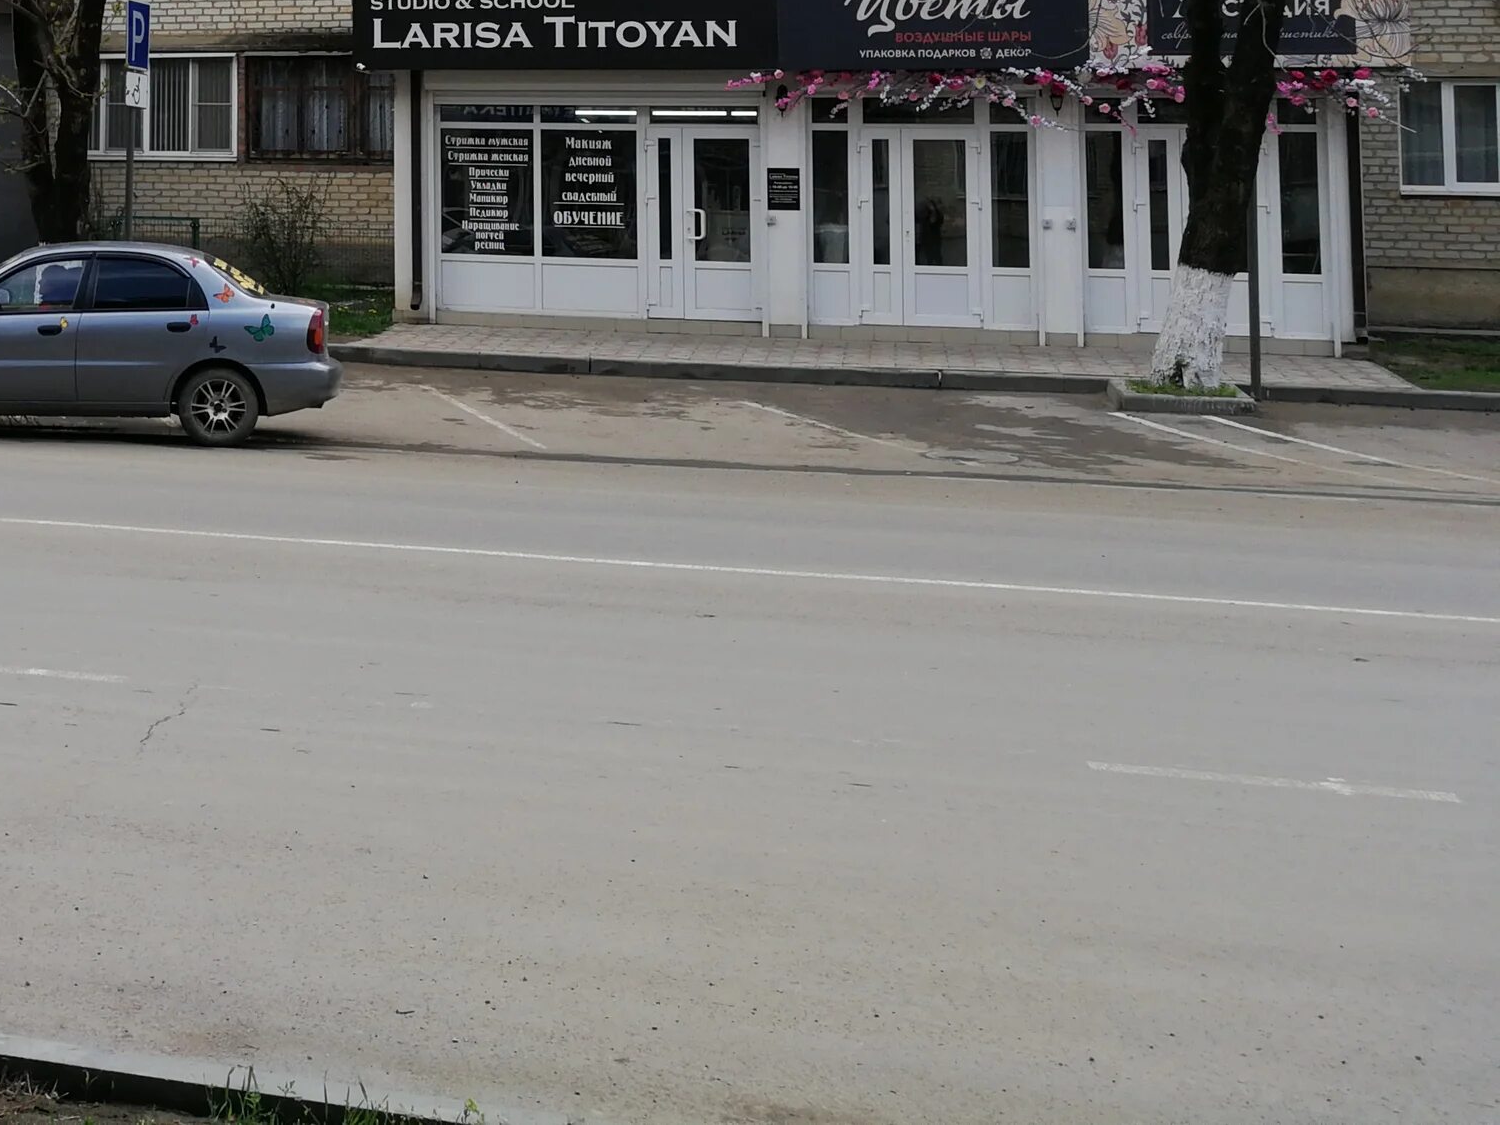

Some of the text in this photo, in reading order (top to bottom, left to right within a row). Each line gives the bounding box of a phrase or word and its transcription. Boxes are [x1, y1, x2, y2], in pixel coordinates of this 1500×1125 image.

[131, 10, 145, 62] P
[895, 30, 1032, 44] ВОЗДУШНЫЕ ШАРЫ
[859, 48, 1032, 59] УПАКОВКА ПОДАРКОВ ДЕКОР
[445, 135, 529, 148] Стрижка мужская
[565, 136, 612, 150] Макияж
[447, 151, 529, 162] Стрижка женская
[568, 156, 612, 167] дневной
[468, 167, 510, 178] Прически
[565, 172, 615, 184] вечерний
[470, 180, 507, 191] Укладки
[469, 193, 509, 205] Маникюр
[561, 191, 617, 202] свадебный
[469, 207, 509, 219] Педикюр
[553, 210, 625, 225] ОБУЧЕНИЕ
[461, 220, 520, 231] Наращивание
[475, 231, 505, 240] ногтей
[474, 240, 506, 252] ресниц
